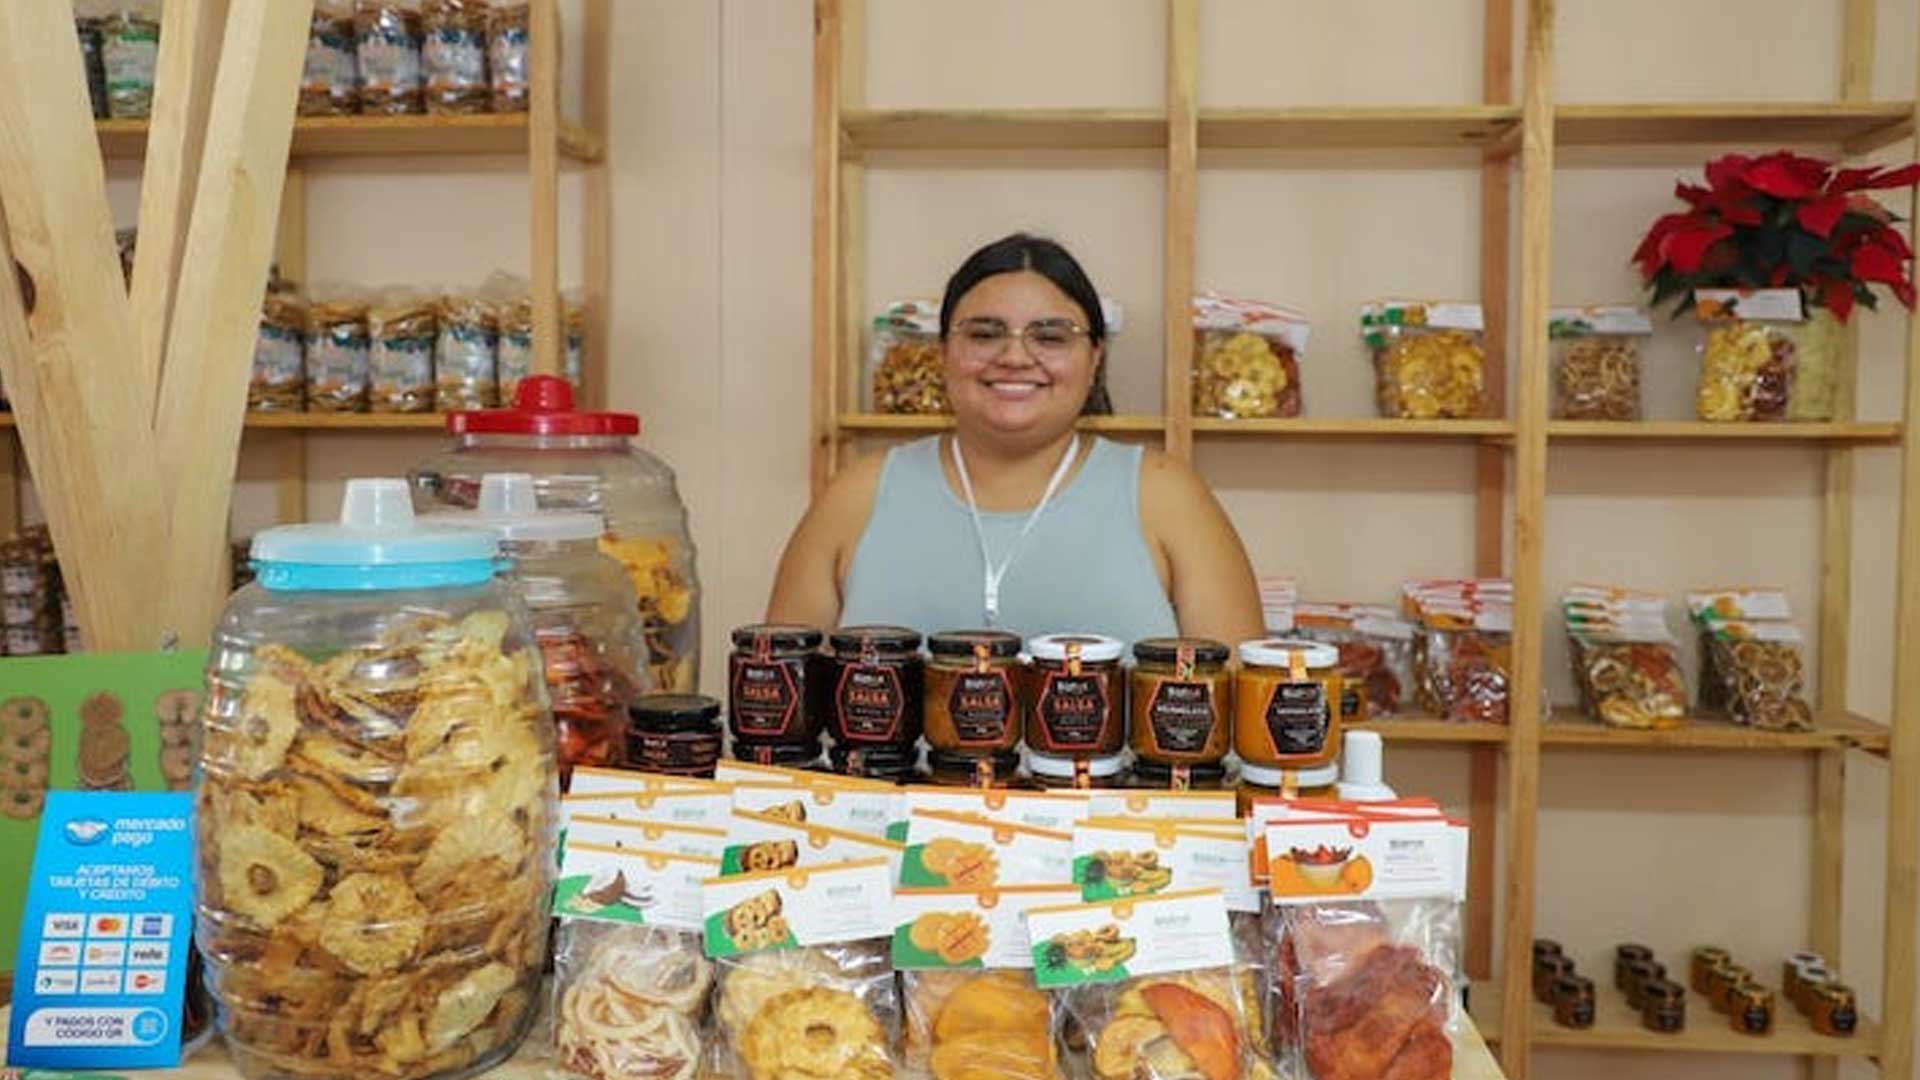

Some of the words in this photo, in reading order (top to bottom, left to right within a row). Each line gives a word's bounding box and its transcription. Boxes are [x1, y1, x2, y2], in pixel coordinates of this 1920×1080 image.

[743, 686, 779, 700] SALSA
[848, 690, 889, 705] SALSA
[960, 694, 1000, 709] SALSA
[1054, 697, 1095, 712] SALSA
[114, 818, 185, 830] mercado
[112, 832, 153, 847] pago
[76, 864, 155, 876] ACEPTAMOS
[50, 876, 110, 888] TARJETAS
[113, 876, 129, 888] DE
[52, 920, 79, 931] VISA
[55, 1016, 95, 1027] PAGOS
[97, 1016, 125, 1027] CON
[105, 1028, 123, 1039] QR
